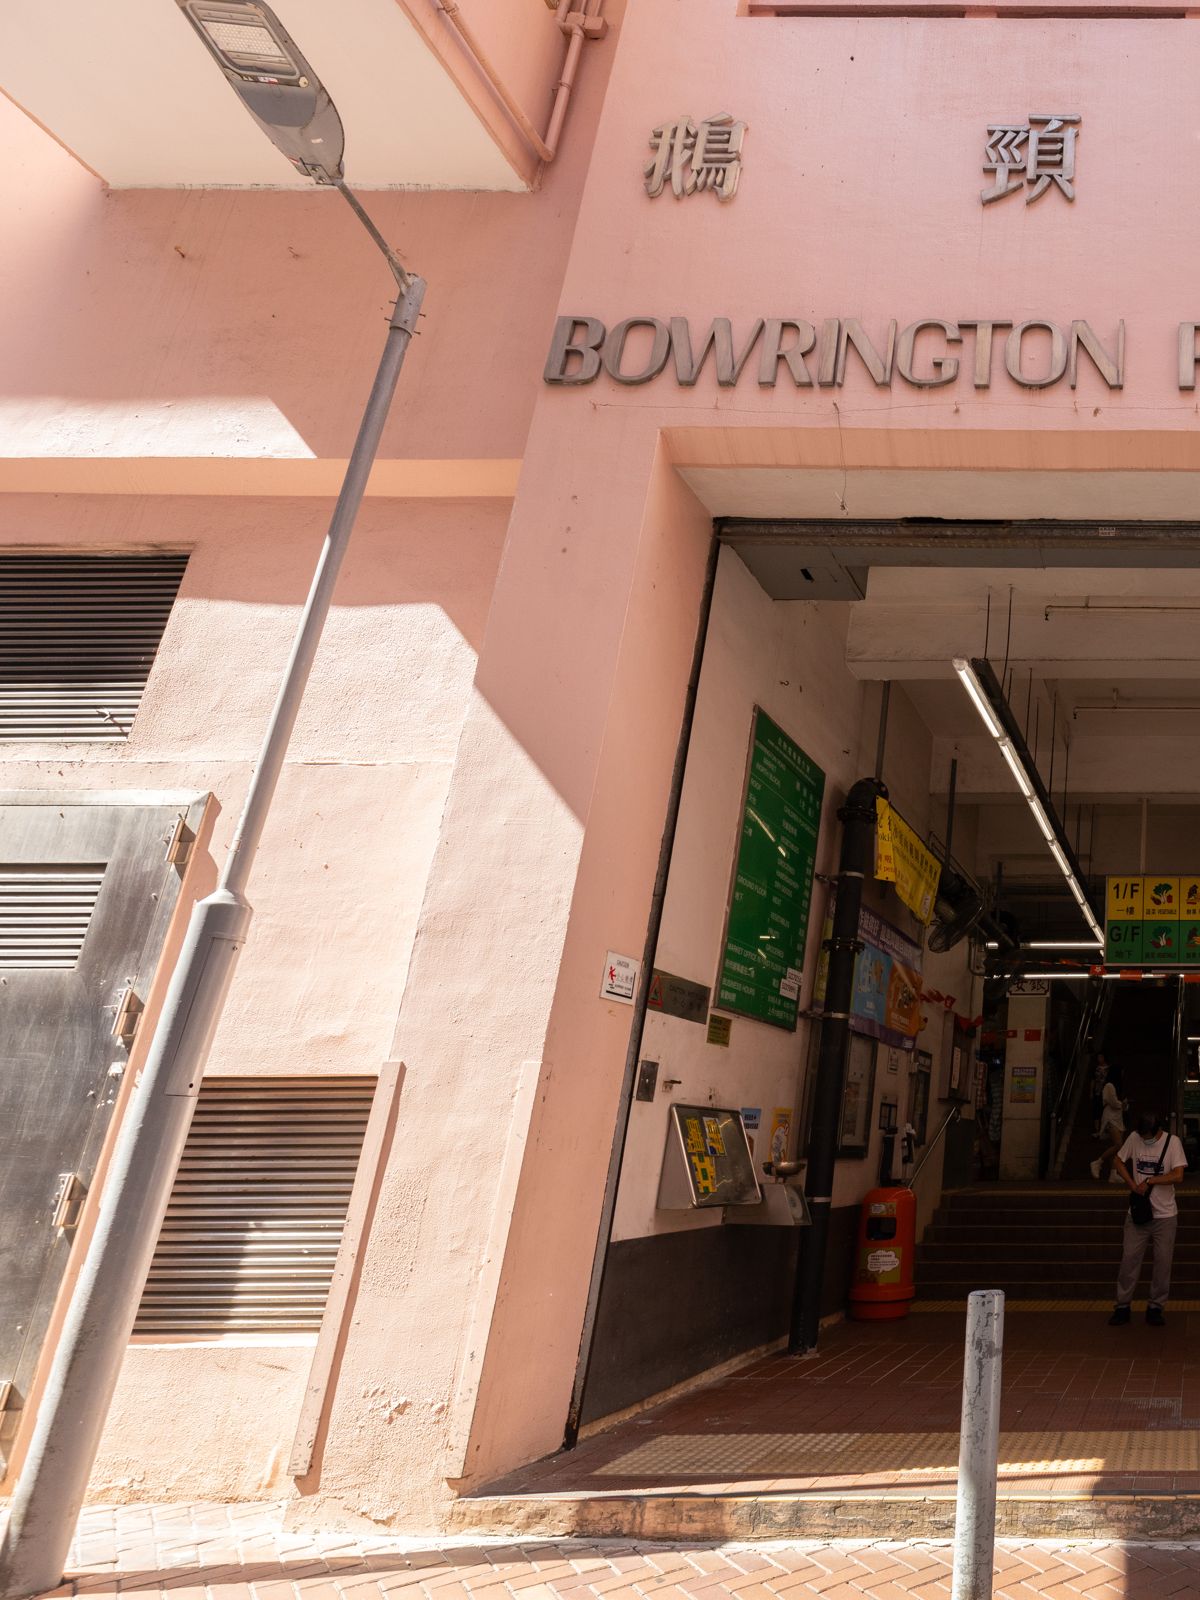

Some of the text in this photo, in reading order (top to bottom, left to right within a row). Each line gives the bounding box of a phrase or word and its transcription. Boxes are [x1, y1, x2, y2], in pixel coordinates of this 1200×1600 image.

[543, 316, 1126, 390] BOWRINGTON
[1113, 883, 1139, 899] 1/F
[1110, 926, 1140, 942] G/F
